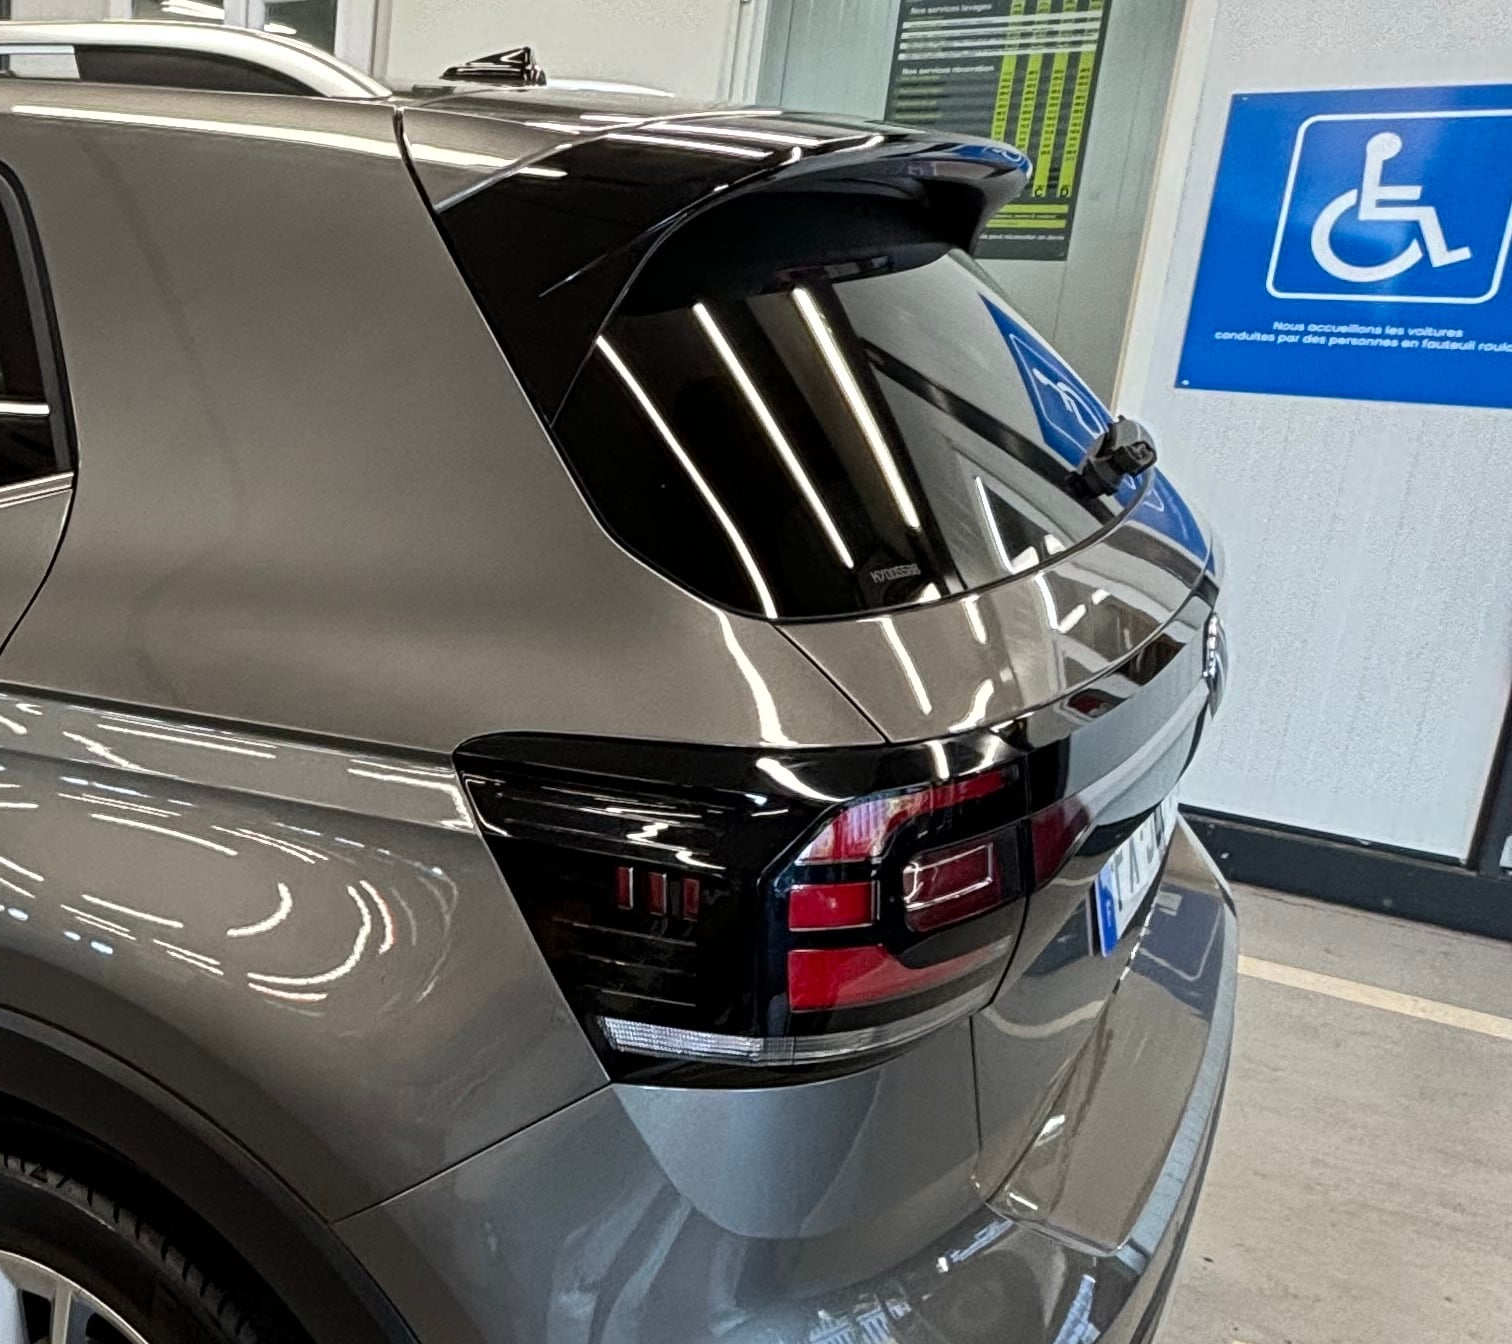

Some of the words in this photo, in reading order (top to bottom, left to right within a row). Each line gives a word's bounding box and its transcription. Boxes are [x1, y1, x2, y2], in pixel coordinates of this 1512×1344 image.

[927, 5, 960, 14] services
[918, 67, 951, 75] services
[1272, 321, 1305, 332] Nous
[1307, 323, 1382, 335] accueillons
[1385, 324, 1405, 336] les
[1408, 326, 1464, 338] voitures
[1214, 330, 1275, 342] conduites
[1277, 334, 1301, 344] par
[1302, 333, 1327, 345] des
[1327, 336, 1399, 348] personnes
[1401, 339, 1419, 348] en
[1421, 339, 1476, 351] fauteuil
